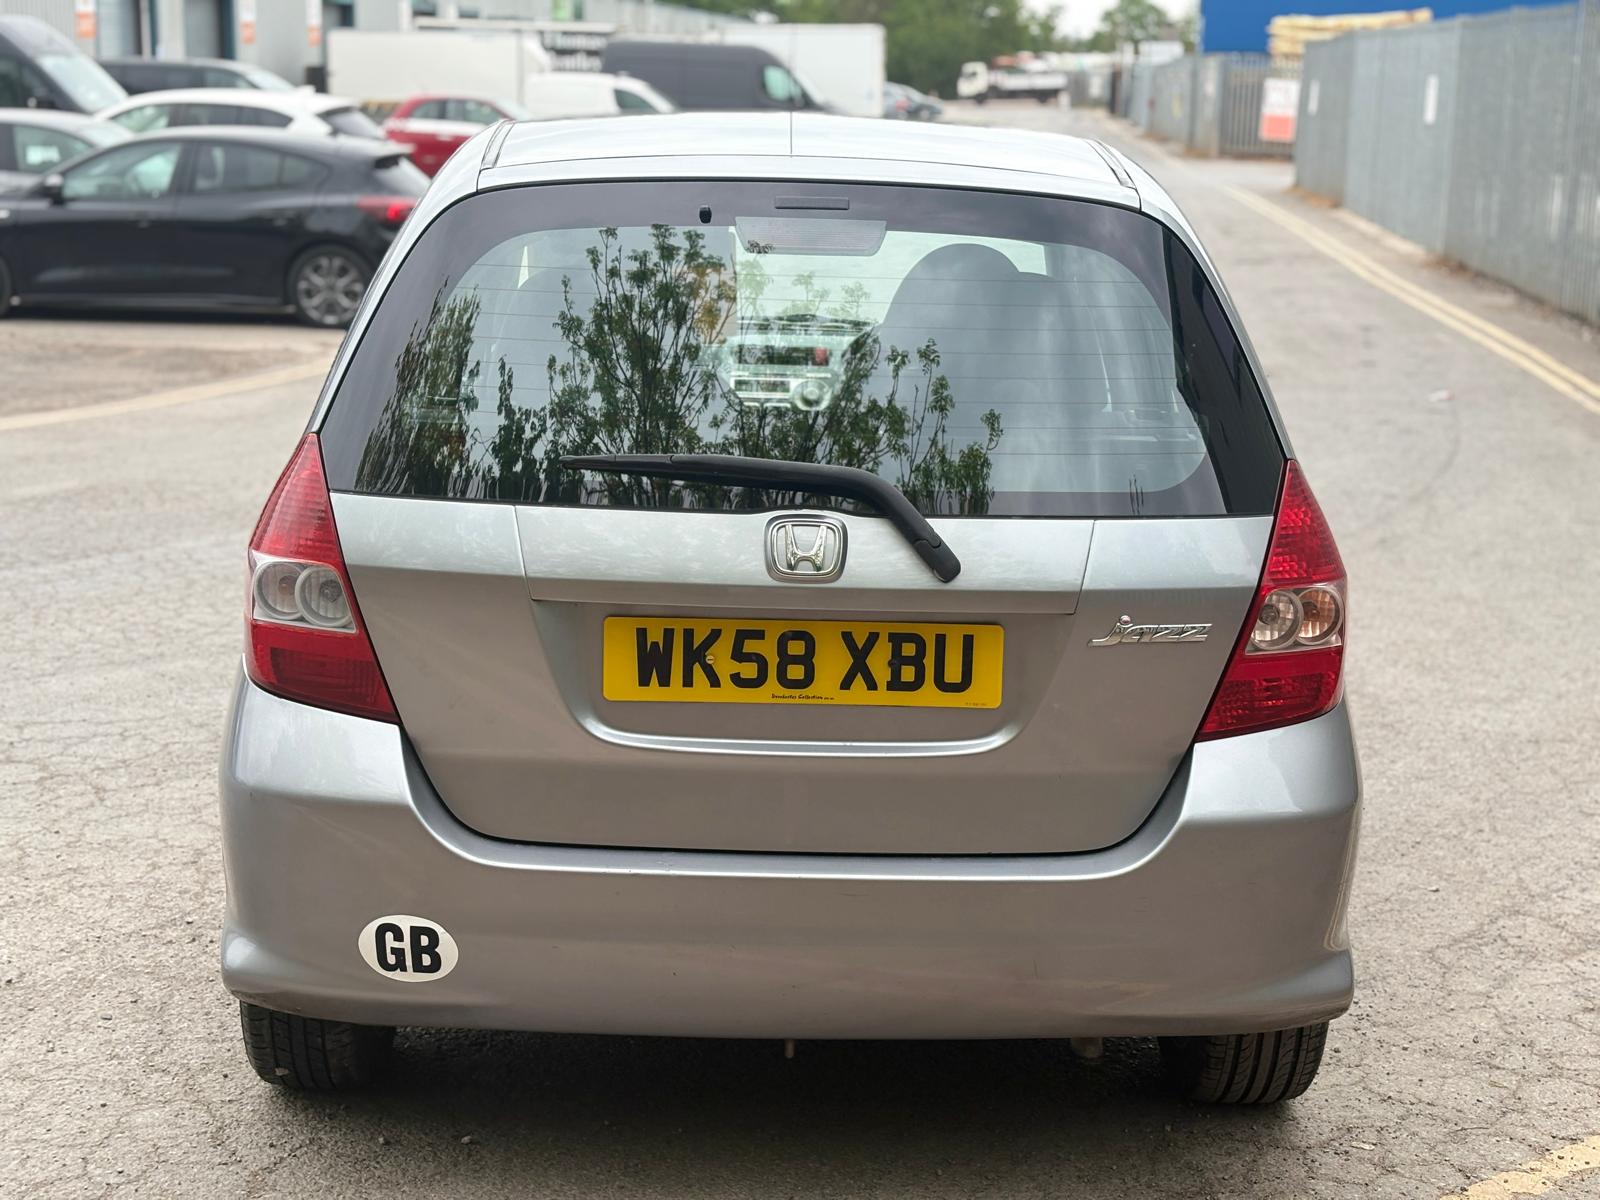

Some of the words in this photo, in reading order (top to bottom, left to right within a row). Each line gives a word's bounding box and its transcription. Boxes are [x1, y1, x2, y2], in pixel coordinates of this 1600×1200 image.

[635, 627, 817, 690] WK58
[839, 630, 975, 693] XBU
[374, 922, 442, 974] GB
